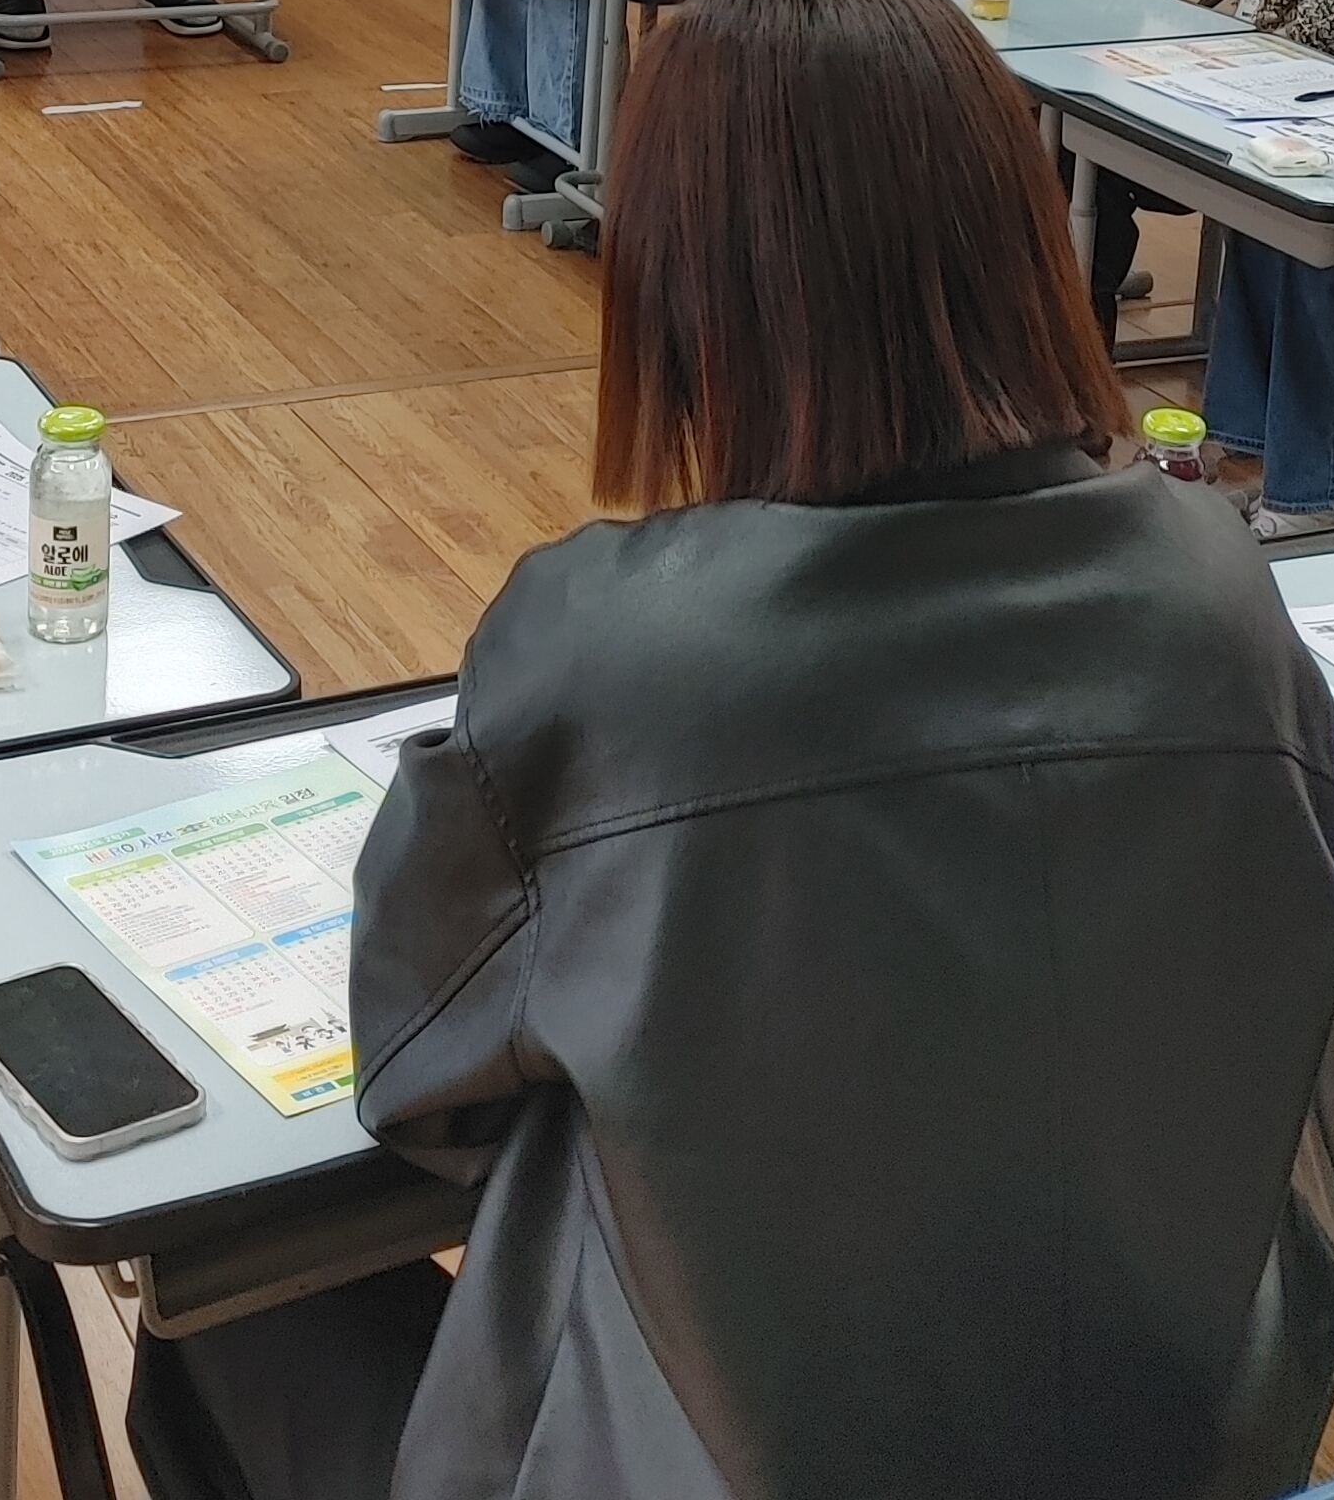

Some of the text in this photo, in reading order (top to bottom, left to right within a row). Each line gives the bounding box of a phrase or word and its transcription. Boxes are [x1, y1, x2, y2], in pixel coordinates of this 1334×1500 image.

[41, 543, 89, 565] 알로에
[43, 565, 68, 577] ALOE
[85, 842, 135, 863] HERO
[278, 787, 317, 805] 일정
